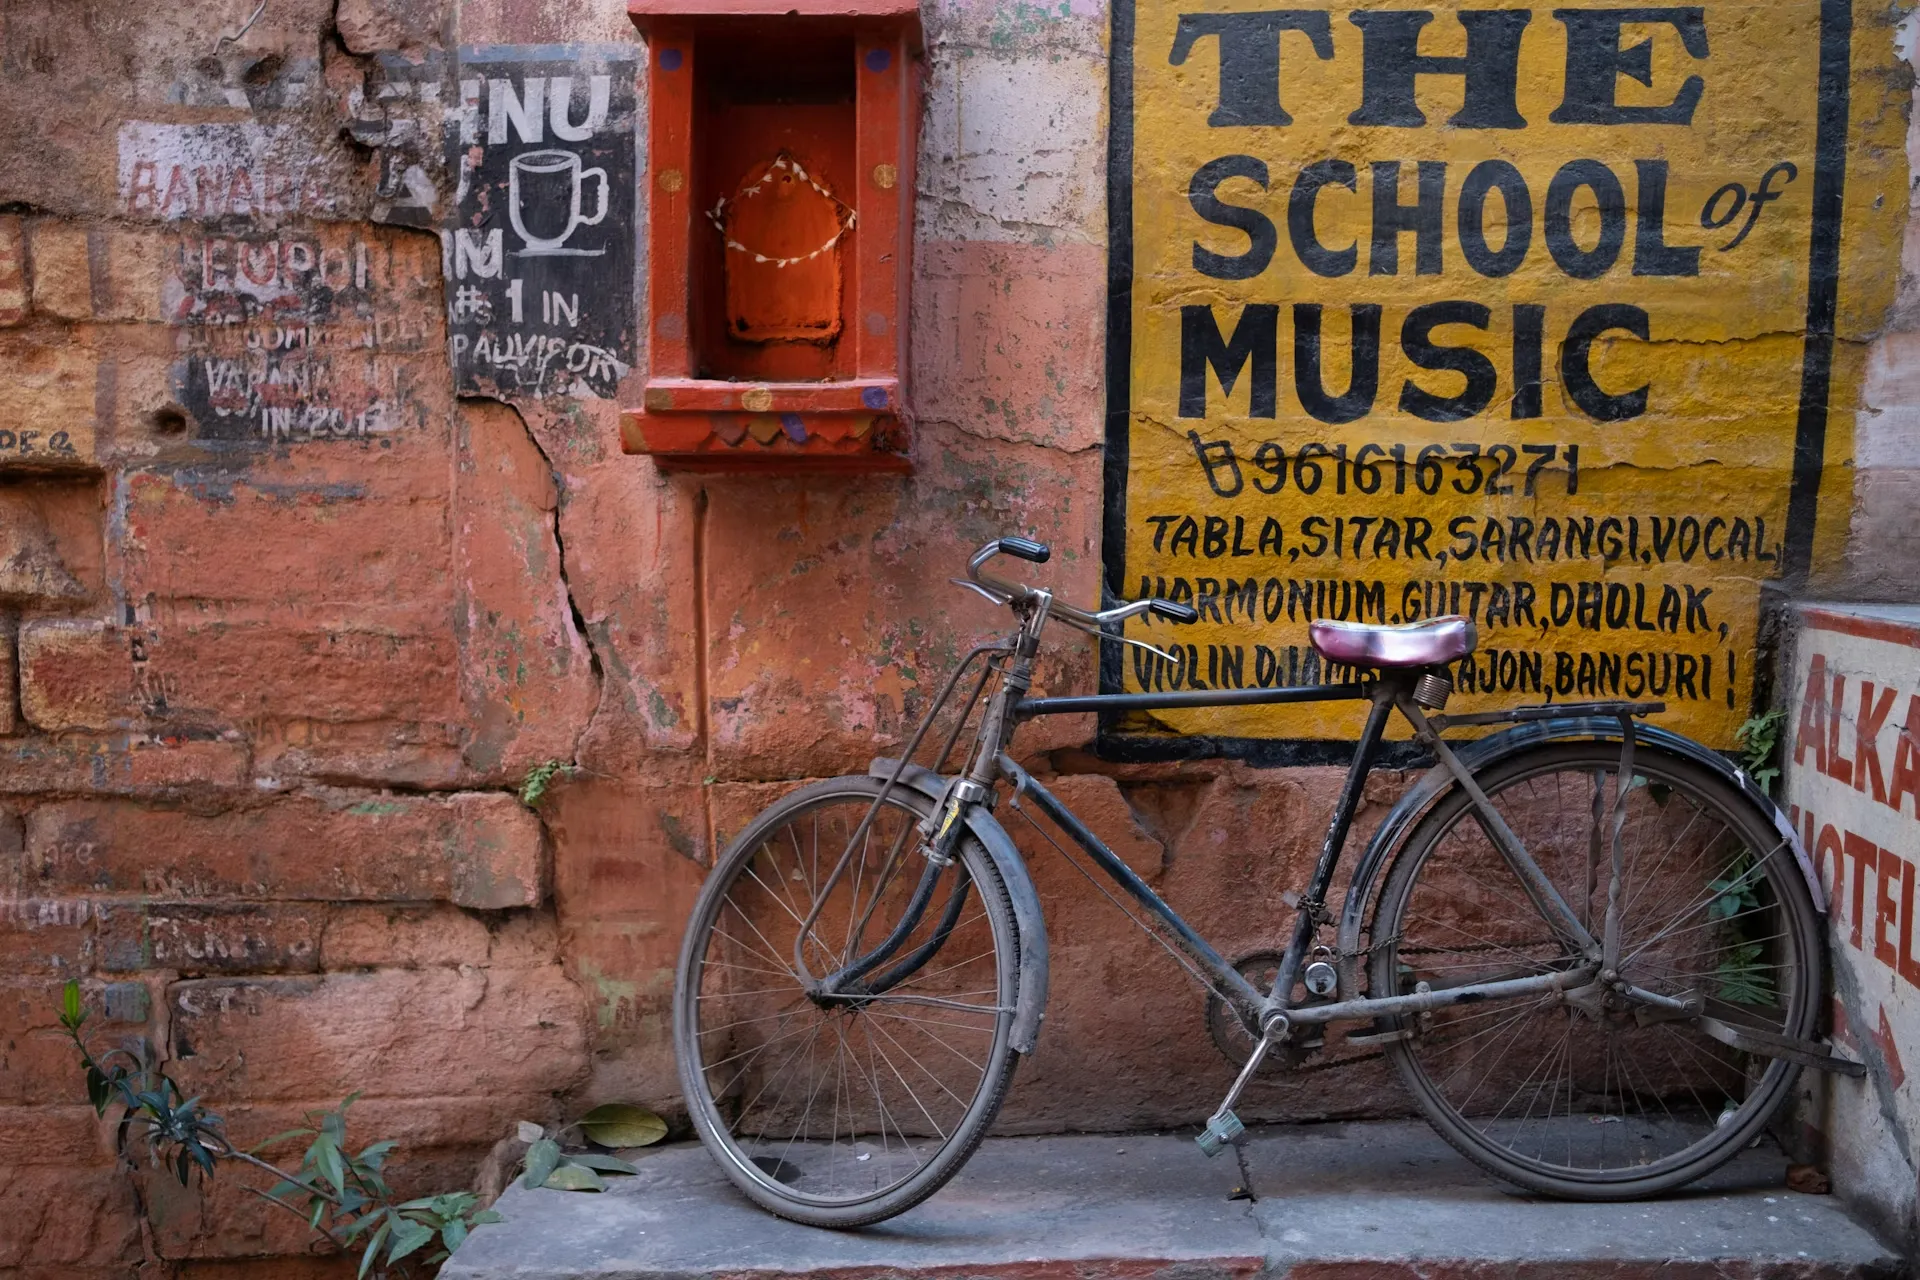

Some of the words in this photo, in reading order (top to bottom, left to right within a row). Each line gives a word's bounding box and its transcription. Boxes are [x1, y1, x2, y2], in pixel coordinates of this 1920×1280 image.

[1170, 7, 1709, 129] THE
[1189, 155, 1703, 279] SCHOOL
[1701, 162, 1798, 251] of
[543, 290, 579, 327] IN
[1179, 301, 1651, 423] MUSIC
[1251, 442, 1579, 497] 9616163271
